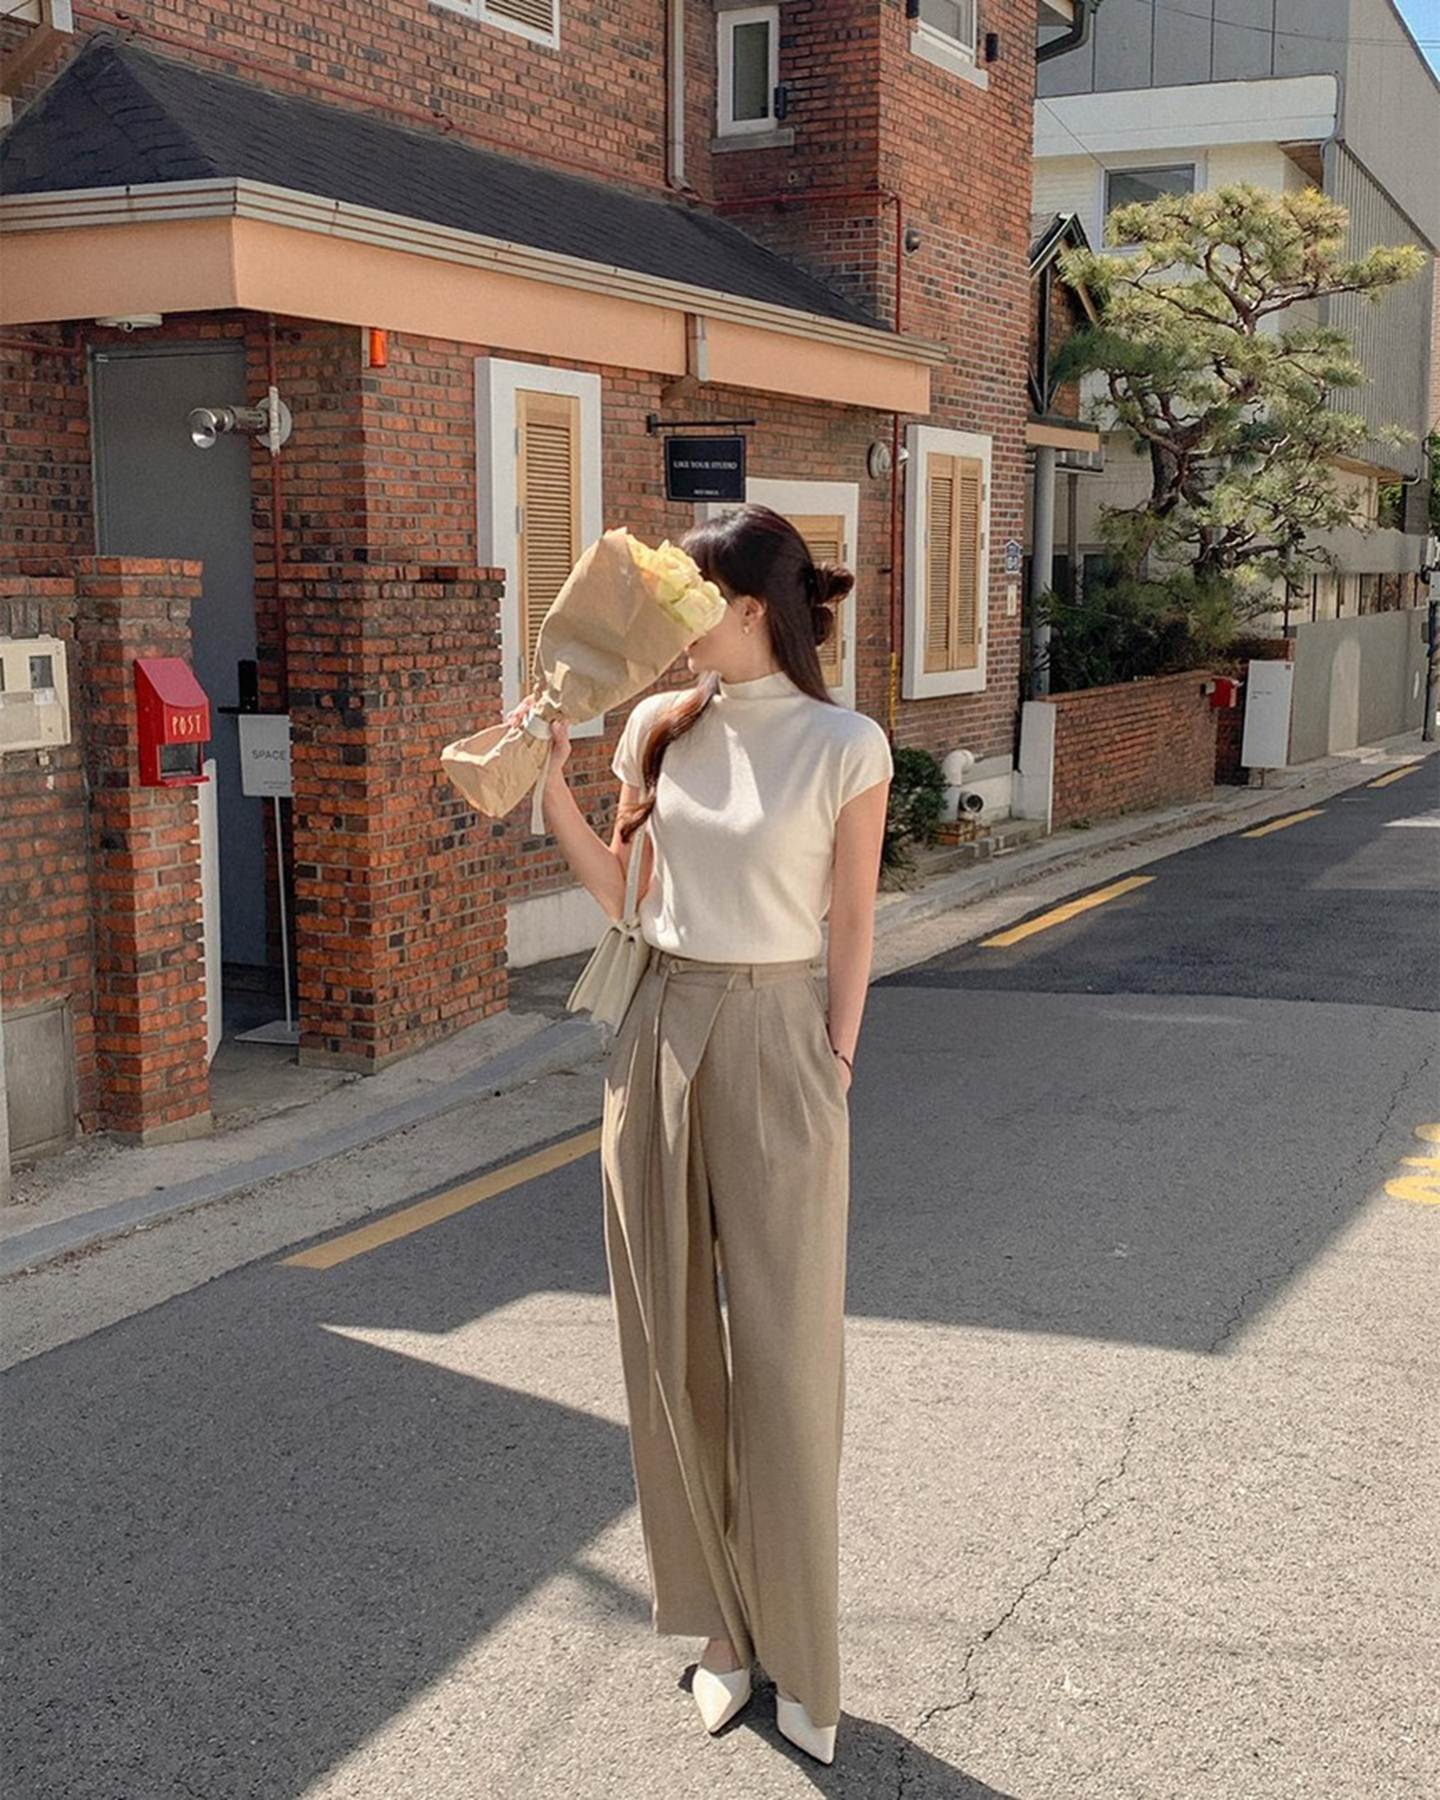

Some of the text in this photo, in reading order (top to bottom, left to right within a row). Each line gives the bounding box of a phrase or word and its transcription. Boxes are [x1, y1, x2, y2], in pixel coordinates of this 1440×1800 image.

[690, 460, 710, 469] YOUR
[711, 461, 738, 470] STUDIO
[172, 715, 201, 736] POST
[252, 749, 287, 761] SPACE
